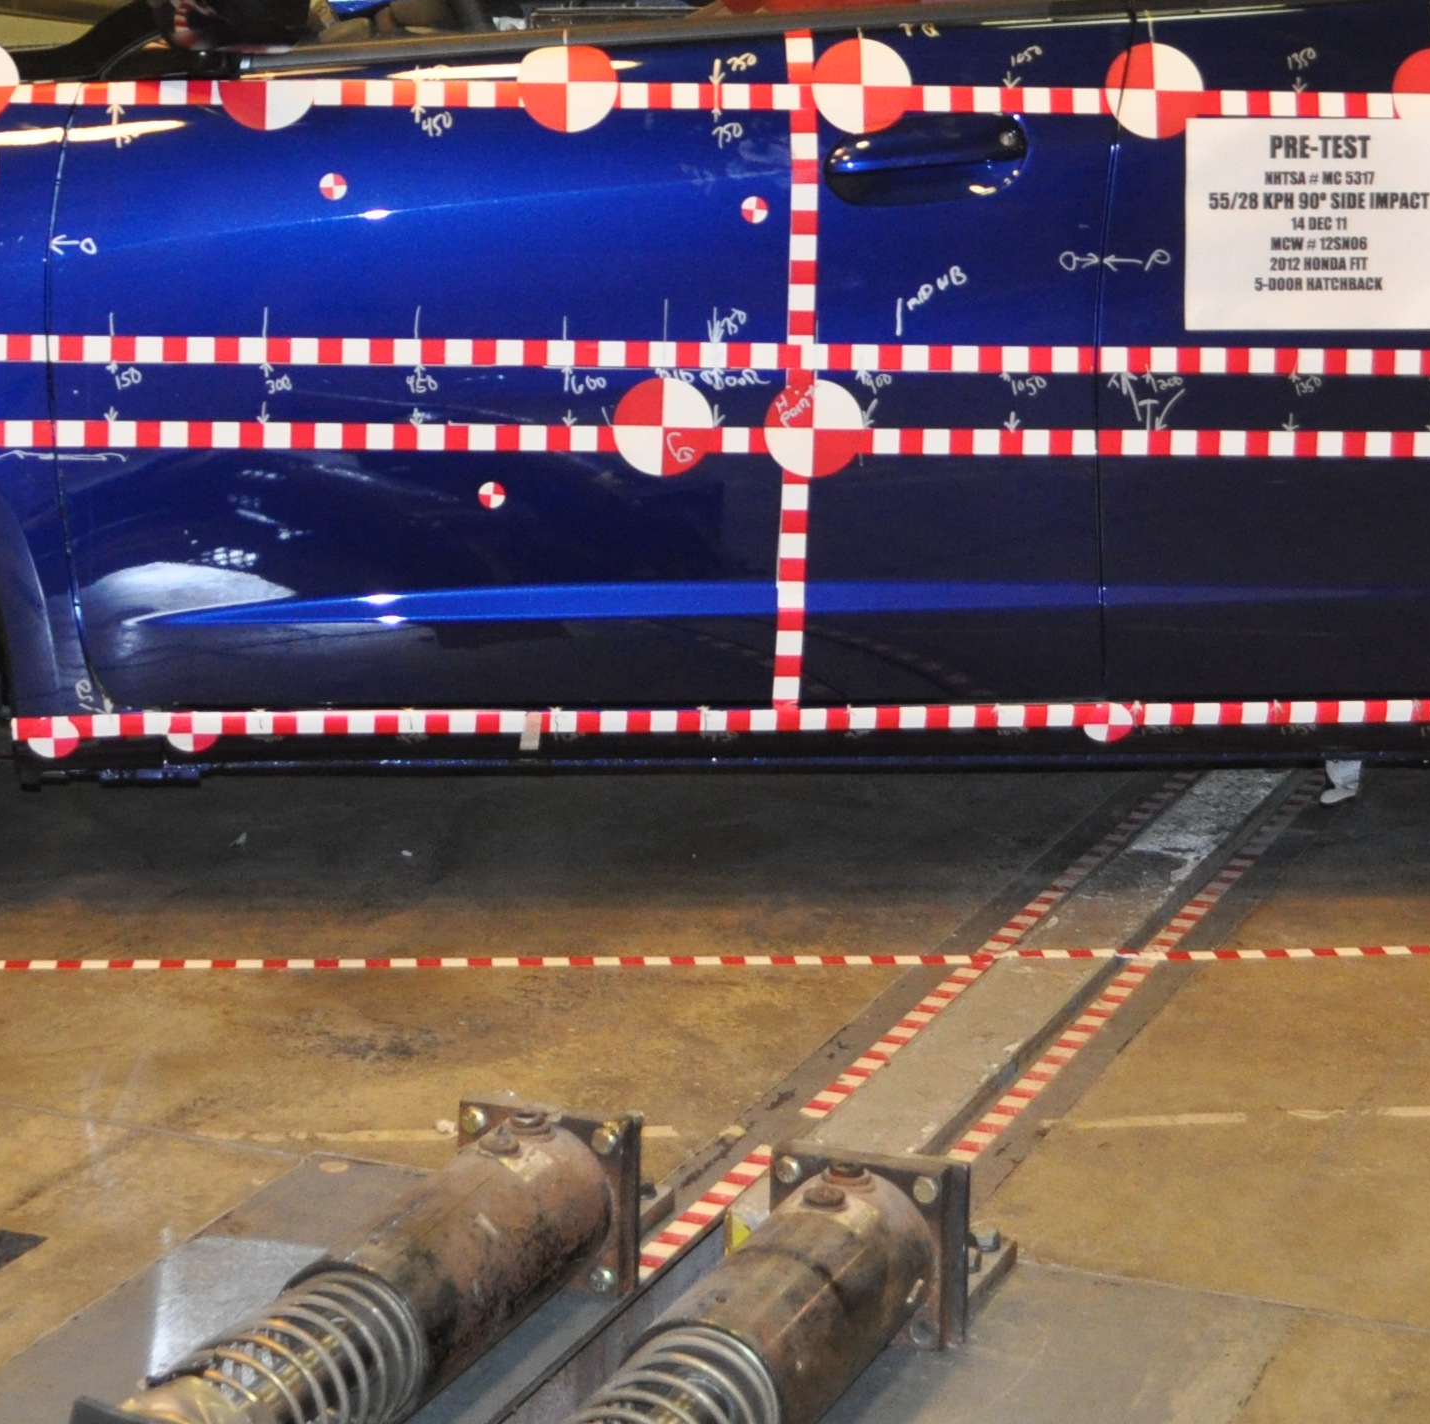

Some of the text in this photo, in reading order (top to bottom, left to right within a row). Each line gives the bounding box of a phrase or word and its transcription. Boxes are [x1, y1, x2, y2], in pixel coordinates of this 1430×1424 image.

[422, 110, 453, 138] 450
[712, 121, 744, 149] 750
[1269, 135, 1371, 159] PRE-TEST
[1264, 171, 1375, 185] NHTSA # MC 5317
[1208, 192, 1259, 210] 55/28
[1263, 192, 1295, 210] KPH
[1330, 192, 1366, 210] SIDE
[1369, 192, 1430, 210] IMPACT
[1291, 217, 1348, 231] 14 DEC 11
[1270, 237, 1368, 251] MCW # 12SN06
[1270, 257, 1368, 271] 2012 HONDA FIT
[1254, 277, 1383, 292] 5-DOOR HATCHBACK
[115, 367, 142, 390] 150
